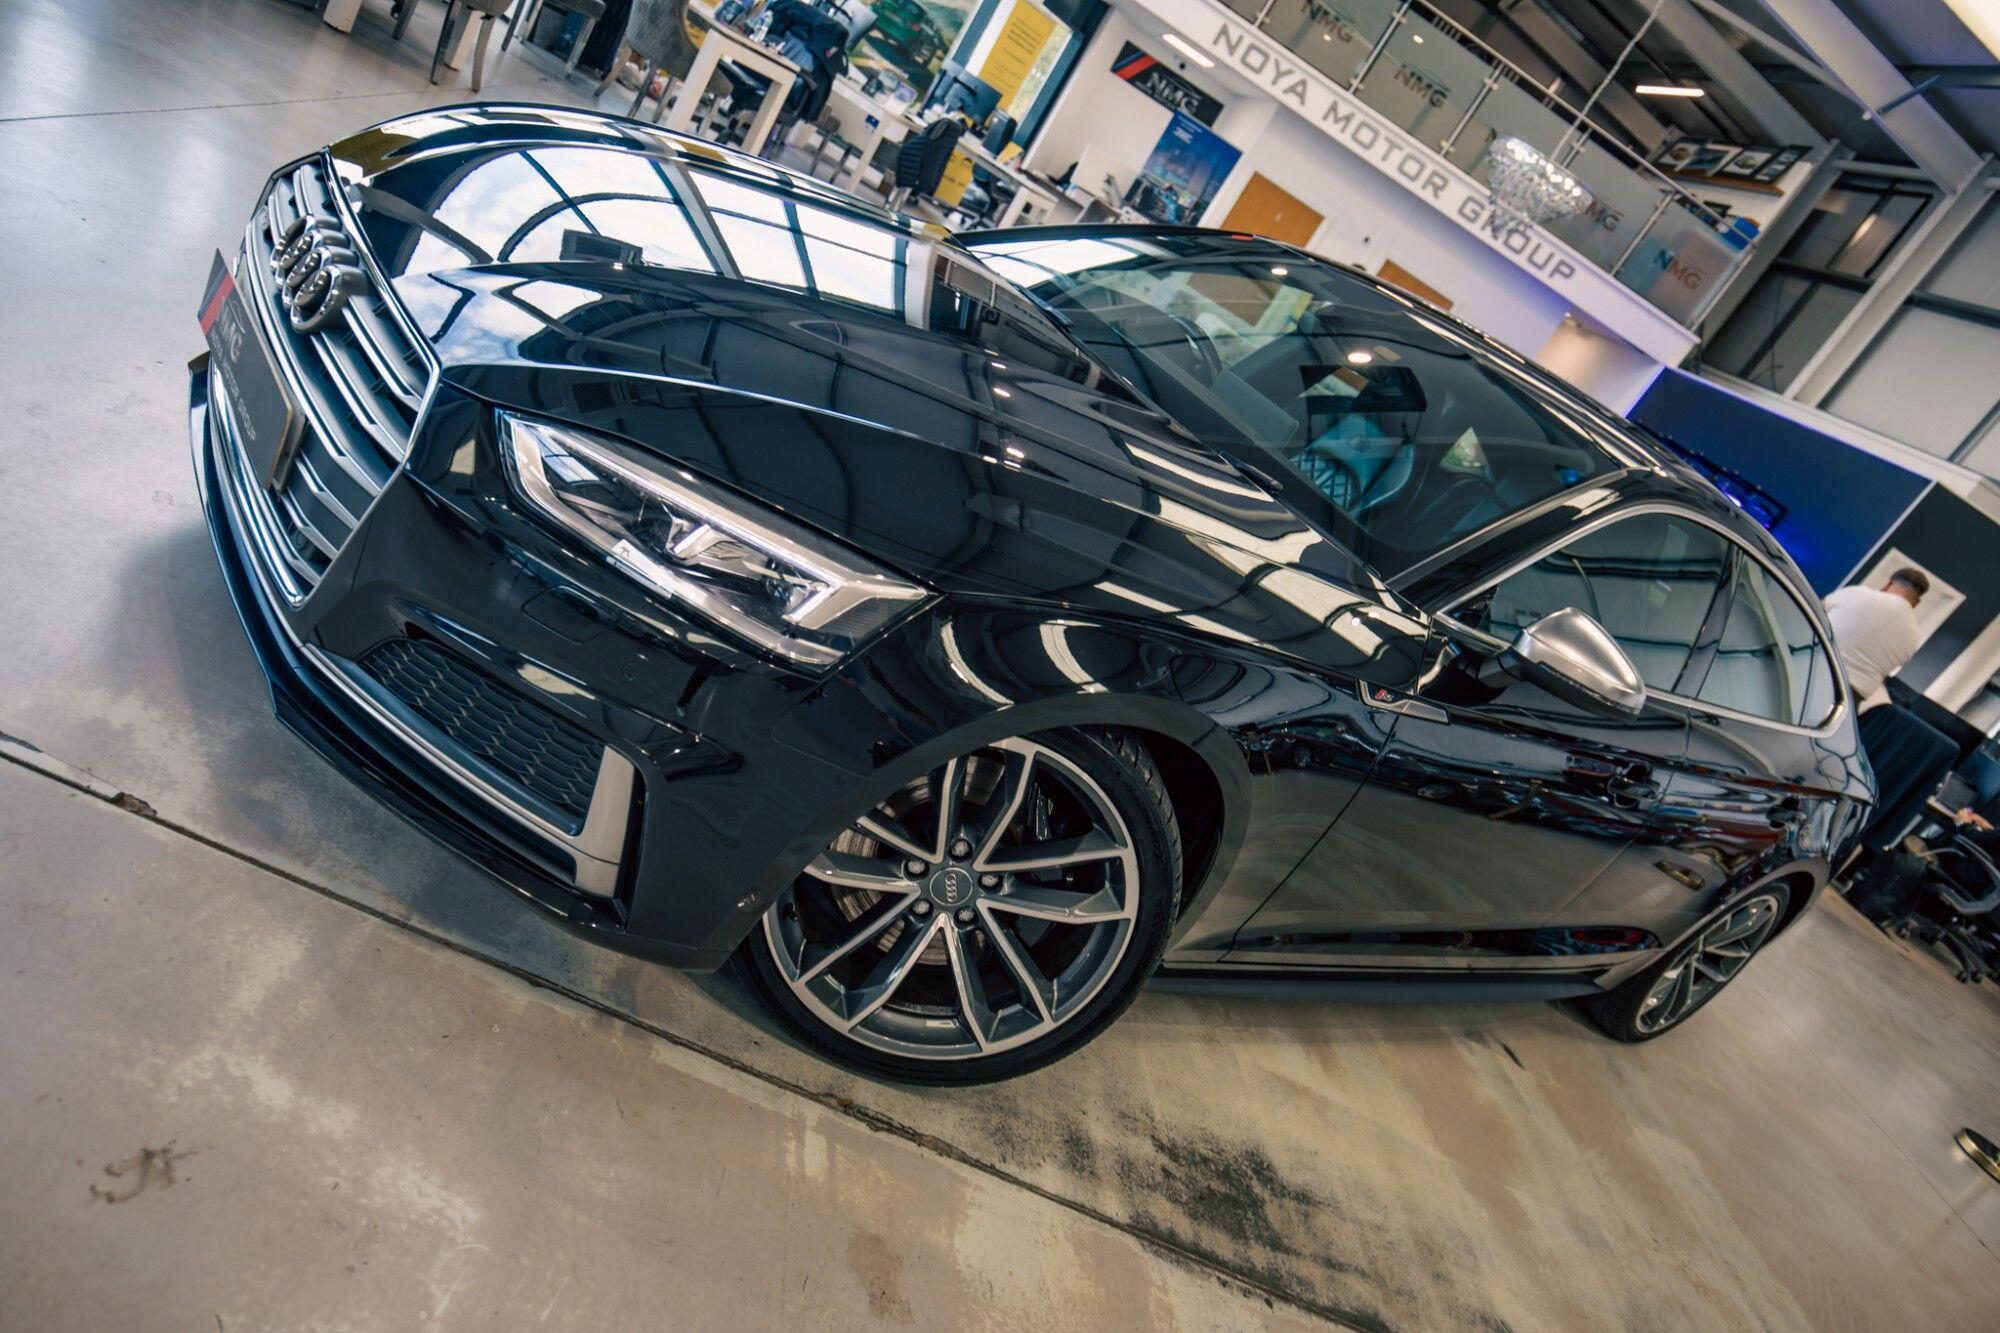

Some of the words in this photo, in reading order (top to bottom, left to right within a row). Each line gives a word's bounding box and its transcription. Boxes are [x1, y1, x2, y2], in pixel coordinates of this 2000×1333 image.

[1300, 0, 1352, 43] NMG
[1147, 71, 1200, 114] NMG
[1393, 64, 1449, 109] NMG
[1212, 22, 1309, 107] NOYA
[1321, 99, 1451, 200] MOTOR
[1653, 249, 1701, 290] NMG
